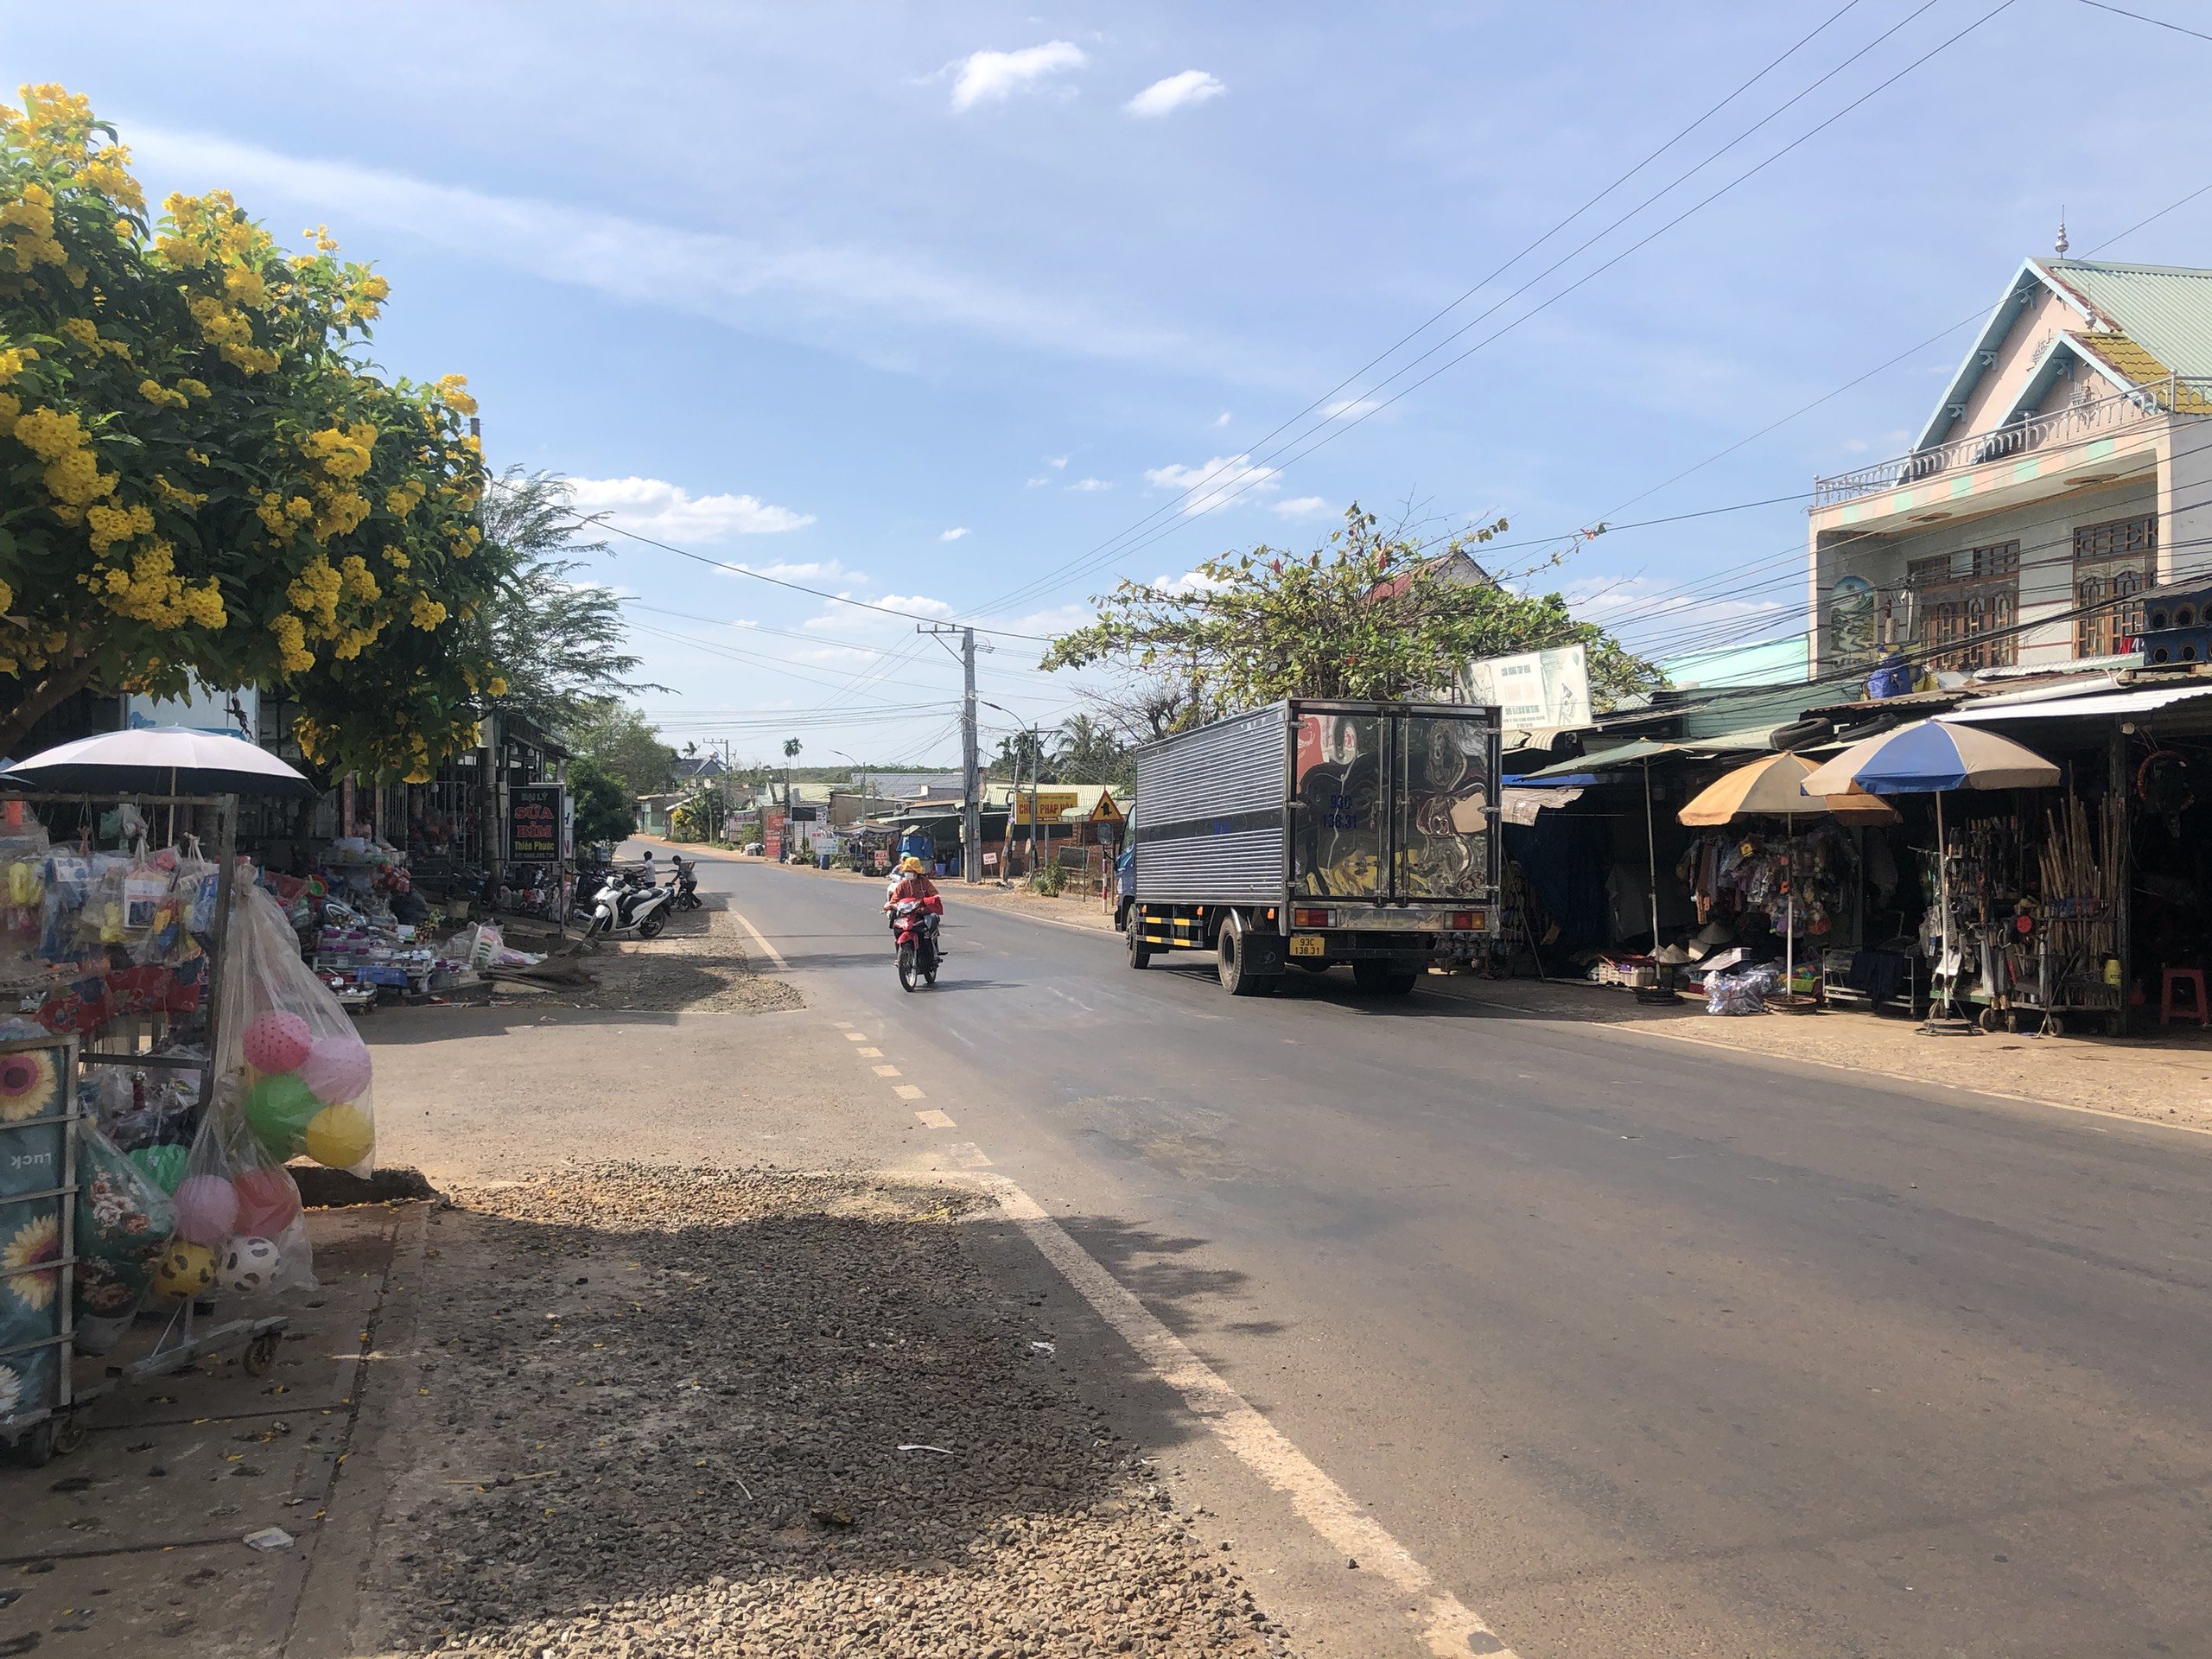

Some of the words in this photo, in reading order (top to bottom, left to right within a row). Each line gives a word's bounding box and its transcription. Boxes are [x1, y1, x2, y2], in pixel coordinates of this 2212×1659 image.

[1039, 801, 1058, 814] PHÁP
[1331, 795, 1351, 810] 93C
[514, 804, 555, 819] SỮA
[517, 821, 552, 837] BỈM
[1322, 814, 1357, 829] 138.31
[11, 1153, 52, 1169] Luck
